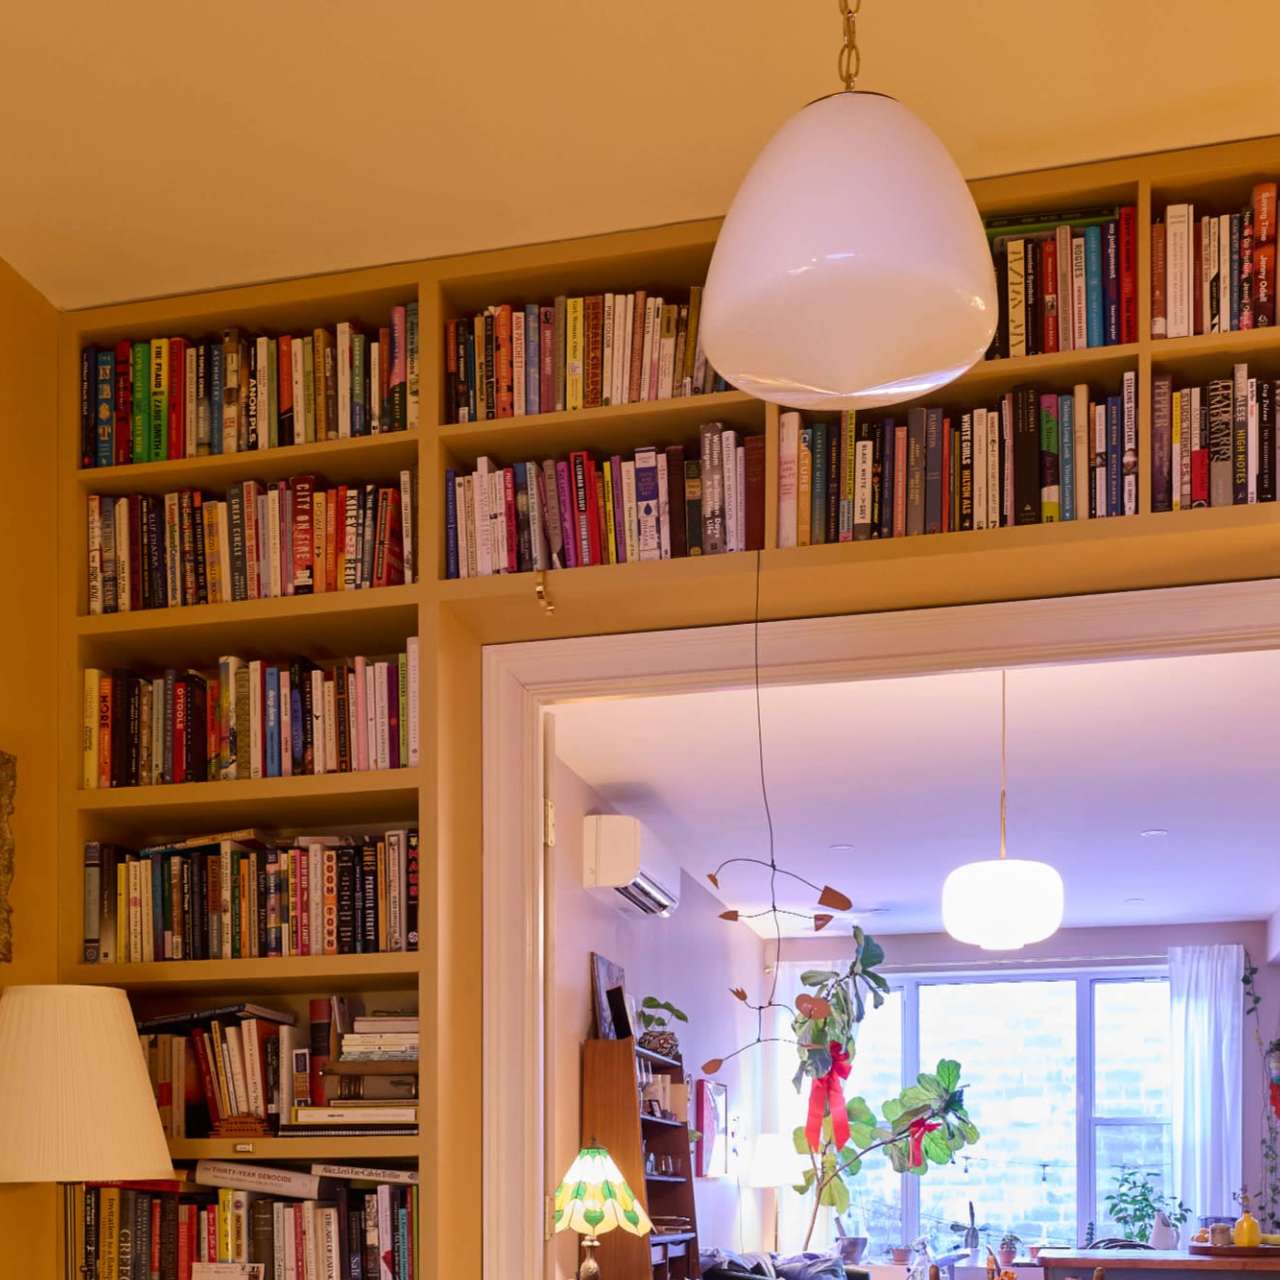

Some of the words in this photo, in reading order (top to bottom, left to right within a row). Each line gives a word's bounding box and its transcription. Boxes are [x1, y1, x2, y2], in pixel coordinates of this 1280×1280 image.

[1260, 193, 1269, 219] Saving
[1075, 244, 1083, 278] ROGUES
[1108, 235, 1116, 279] judgement
[1258, 255, 1267, 279] Jenny
[1259, 280, 1267, 302] Odell
[514, 315, 522, 331] ANN
[591, 301, 600, 352] MICHAEL
[590, 356, 600, 405] CHABON
[1154, 381, 1169, 428] PEPPER
[962, 414, 971, 440] WHITE
[1062, 426, 1071, 444] Long
[704, 433, 712, 470] Finnegan
[712, 434, 720, 465] William
[962, 443, 971, 464] GIRLS
[1237, 430, 1248, 451] HIGH
[800, 433, 809, 491] CULTURE
[1237, 455, 1248, 484] NOTES
[712, 474, 720, 515] Barbarian
[963, 470, 971, 496] HILTON
[296, 484, 309, 509] CITY
[577, 489, 585, 511] TRILOGY
[963, 499, 971, 514] ALS
[231, 498, 239, 524] GREAT
[297, 515, 309, 530] ON
[345, 495, 356, 528] KILEY
[706, 520, 714, 534] Life
[712, 518, 721, 538] Days
[232, 528, 241, 555] CIRCLE
[297, 533, 310, 559] FIRE
[345, 559, 356, 584] REID
[324, 854, 335, 896] BOOM
[212, 1167, 256, 1180] THIRTY-YEAR
[257, 1174, 292, 1183] GENOCIDE
[106, 1198, 115, 1239] Invitation
[351, 1256, 361, 1278] Salt
